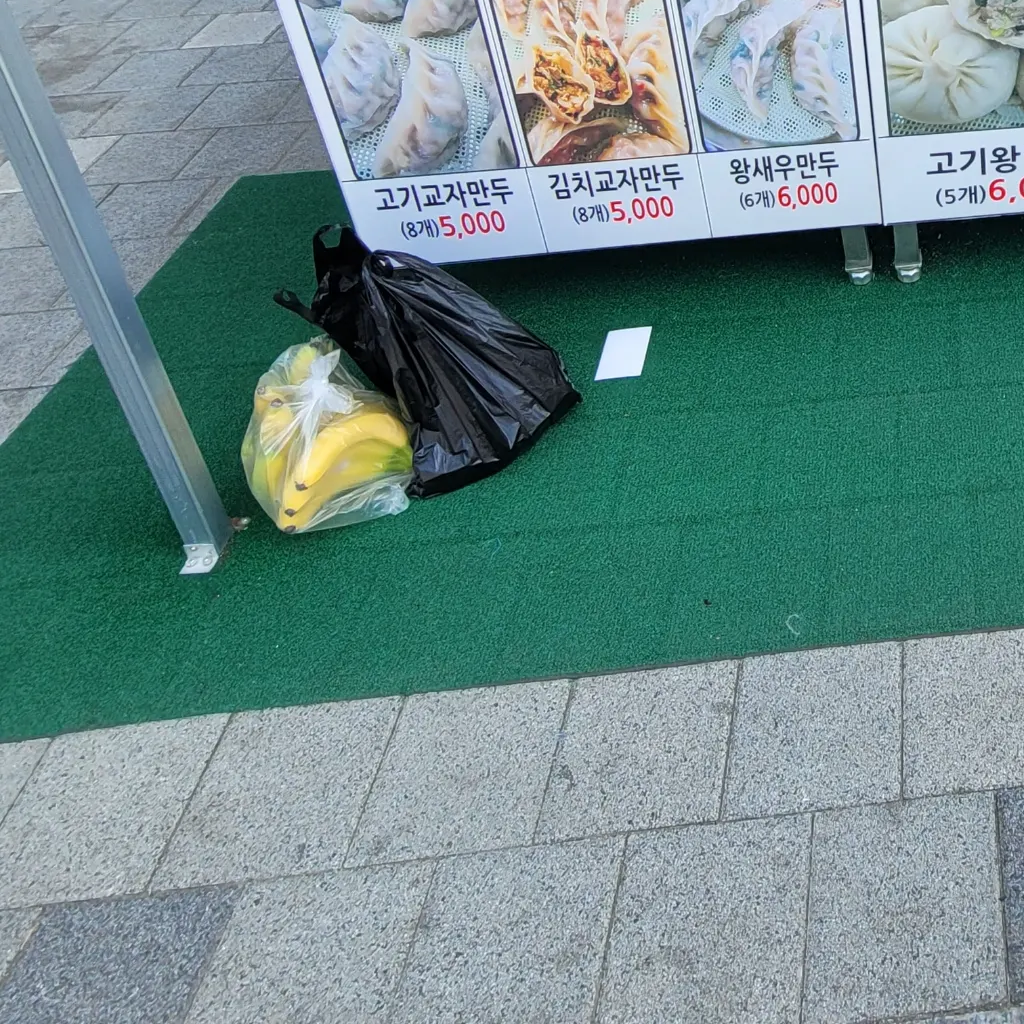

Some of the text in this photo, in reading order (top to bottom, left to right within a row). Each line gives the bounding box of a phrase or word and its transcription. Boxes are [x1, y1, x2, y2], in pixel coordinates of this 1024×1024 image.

[548, 162, 685, 198] 김치교자만두
[729, 150, 840, 185] 왕새우만두
[375, 176, 514, 212] 고기교자만두
[610, 195, 674, 225] 5,000
[777, 182, 839, 210] 6,000
[440, 210, 506, 240] 5,000
